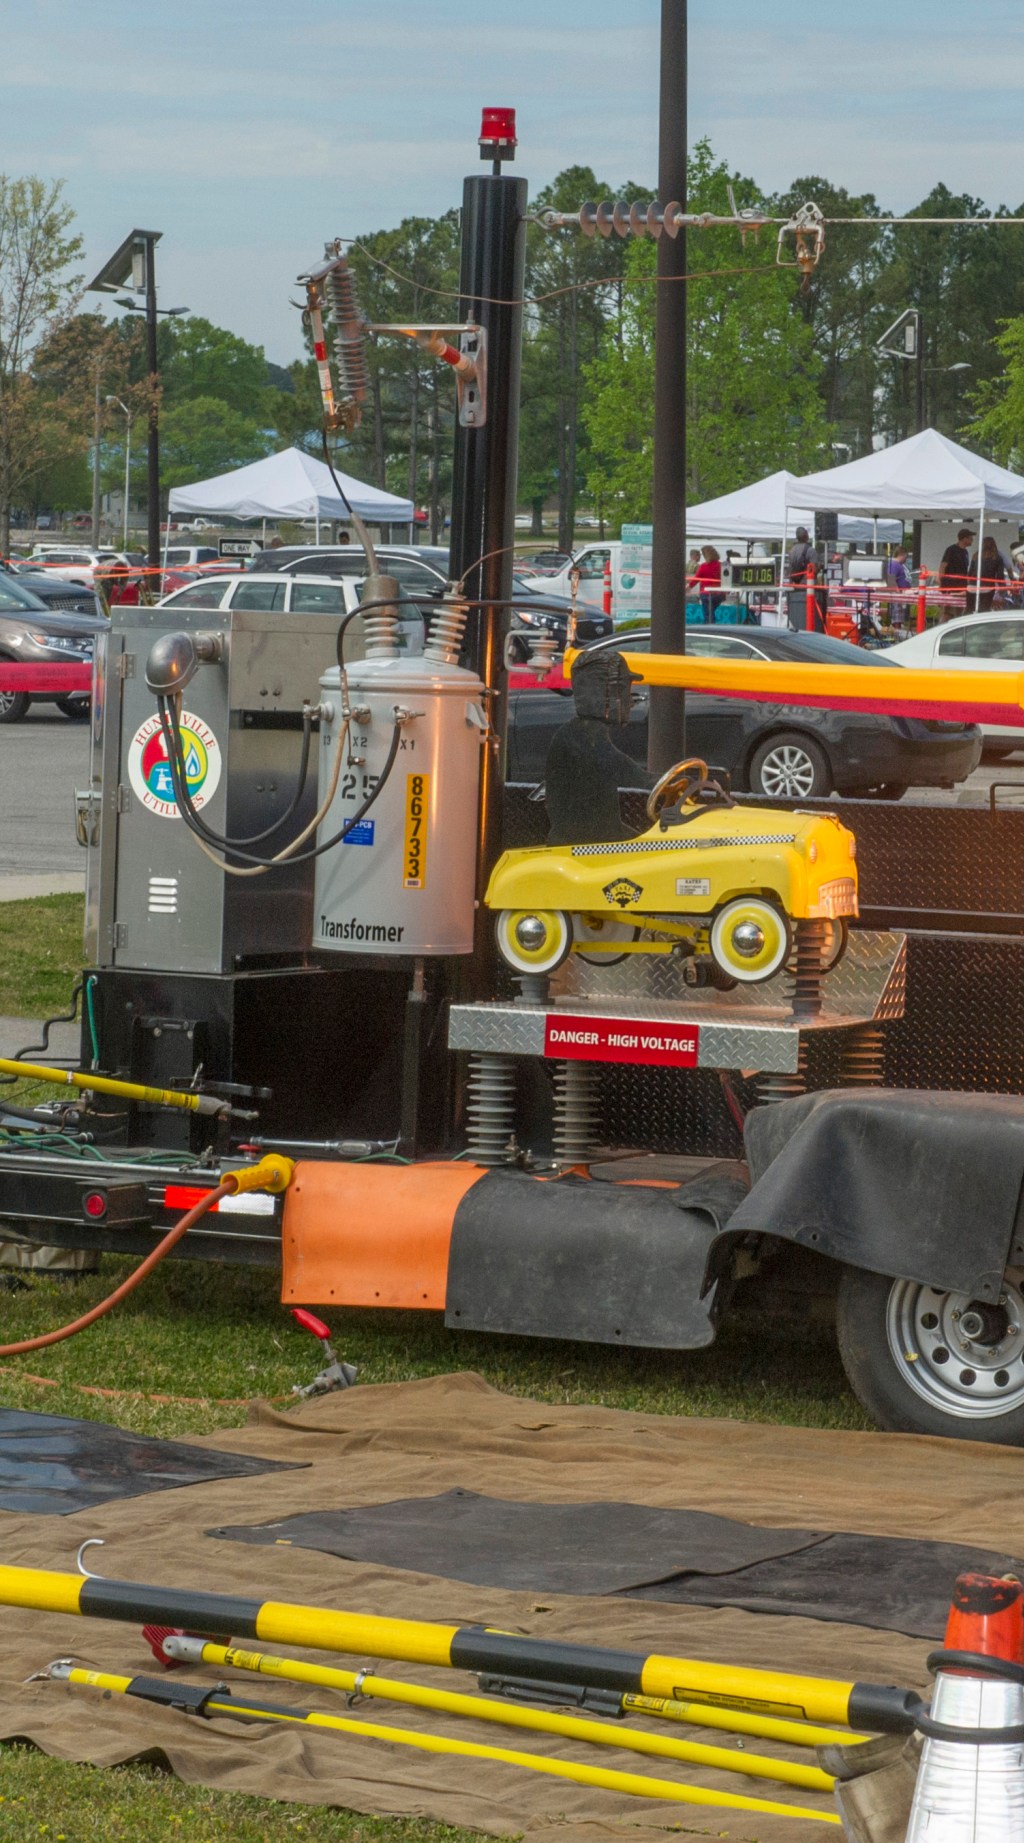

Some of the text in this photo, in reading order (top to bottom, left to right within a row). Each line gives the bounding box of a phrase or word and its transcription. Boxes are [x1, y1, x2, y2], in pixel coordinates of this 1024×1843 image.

[224, 544, 250, 552] ONE WAY
[342, 774, 380, 800] 25
[408, 776, 424, 879] 86733
[615, 885, 631, 893] TAXI
[320, 915, 404, 944] Transformer
[549, 1029, 599, 1045] DANGER
[608, 1034, 638, 1048] HIGH
[640, 1036, 695, 1052] VOLTAGE
